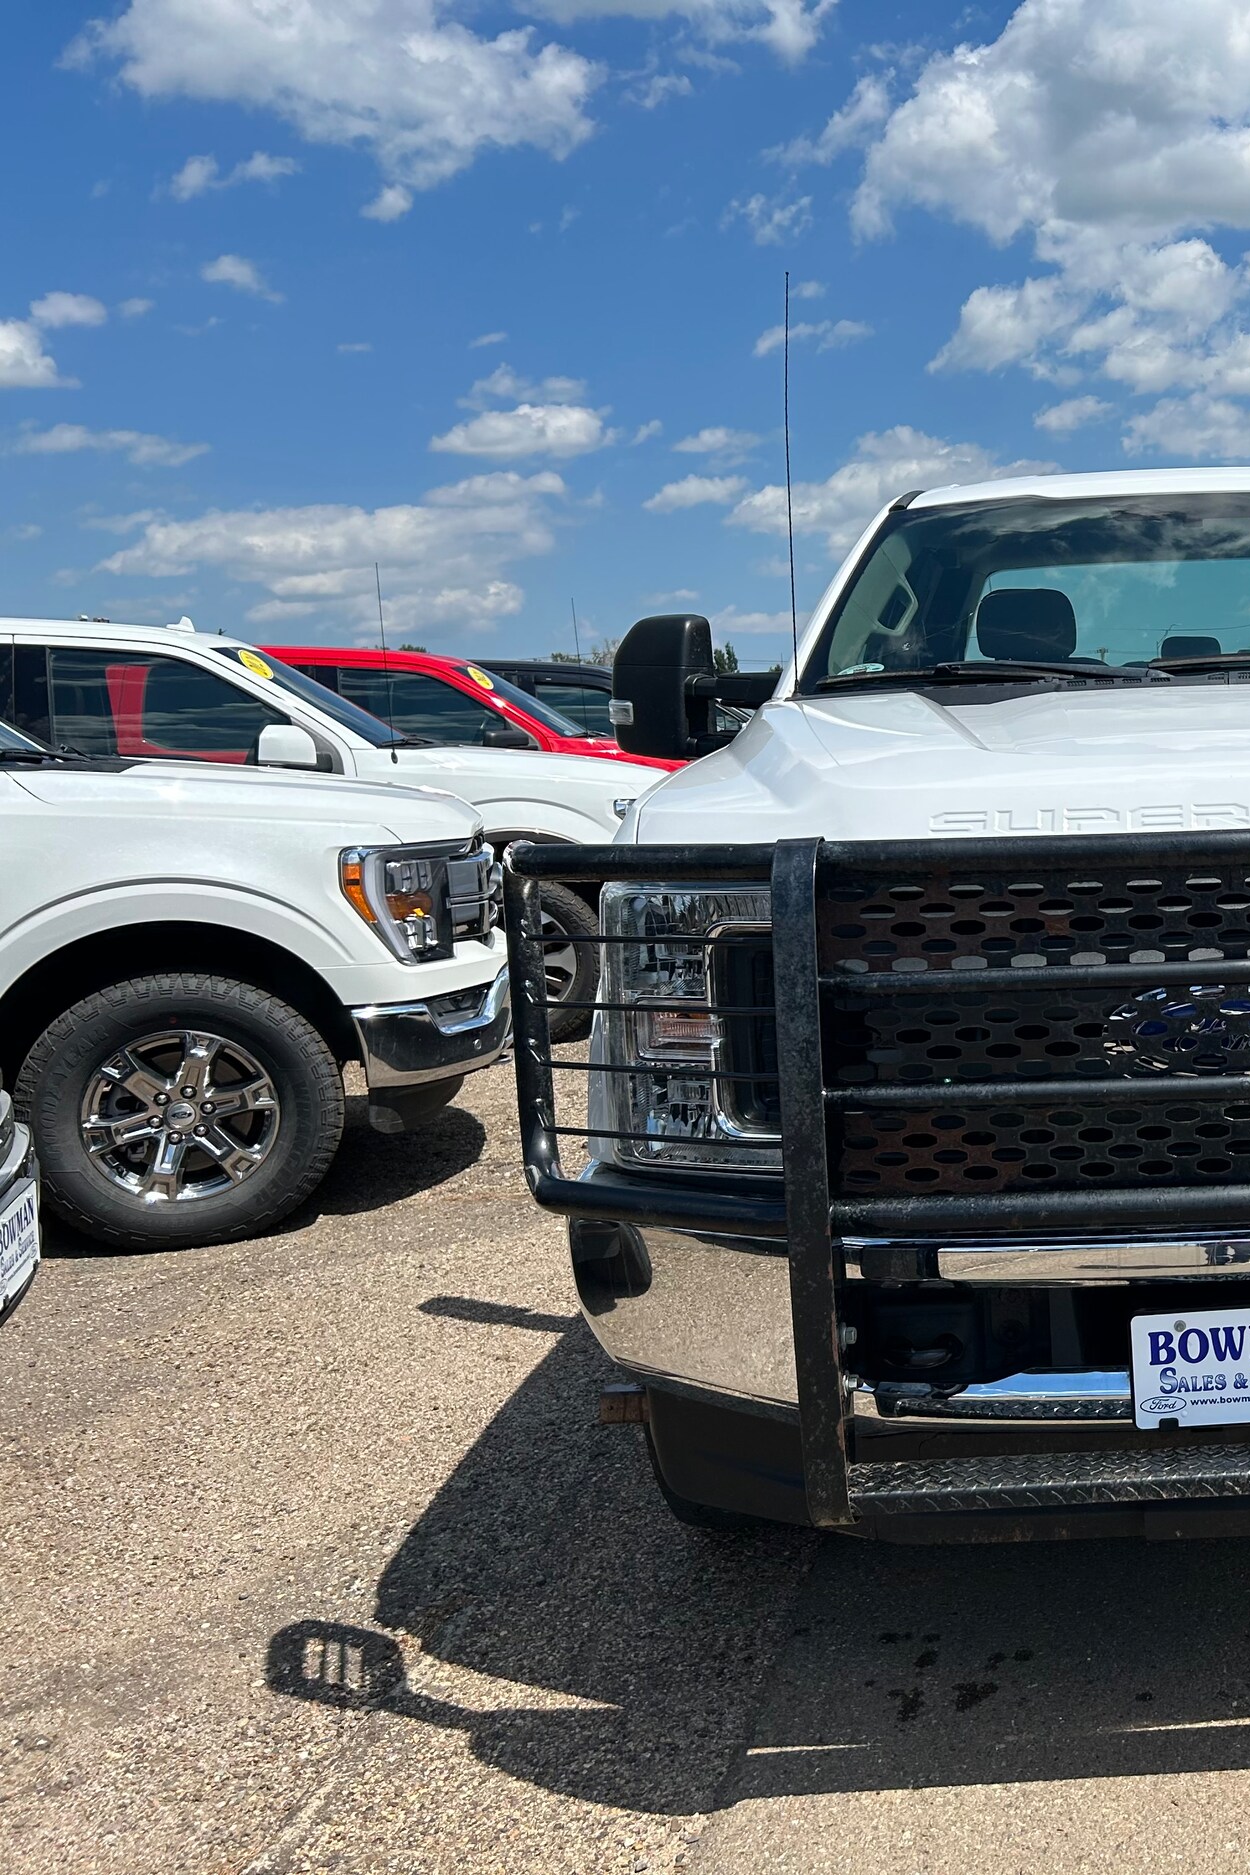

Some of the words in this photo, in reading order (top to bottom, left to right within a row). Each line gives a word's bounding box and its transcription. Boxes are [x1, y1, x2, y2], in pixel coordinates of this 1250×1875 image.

[929, 803, 1250, 834] SUPER
[1159, 1367, 1227, 1395] SALES
[1233, 1372, 1249, 1390] &
